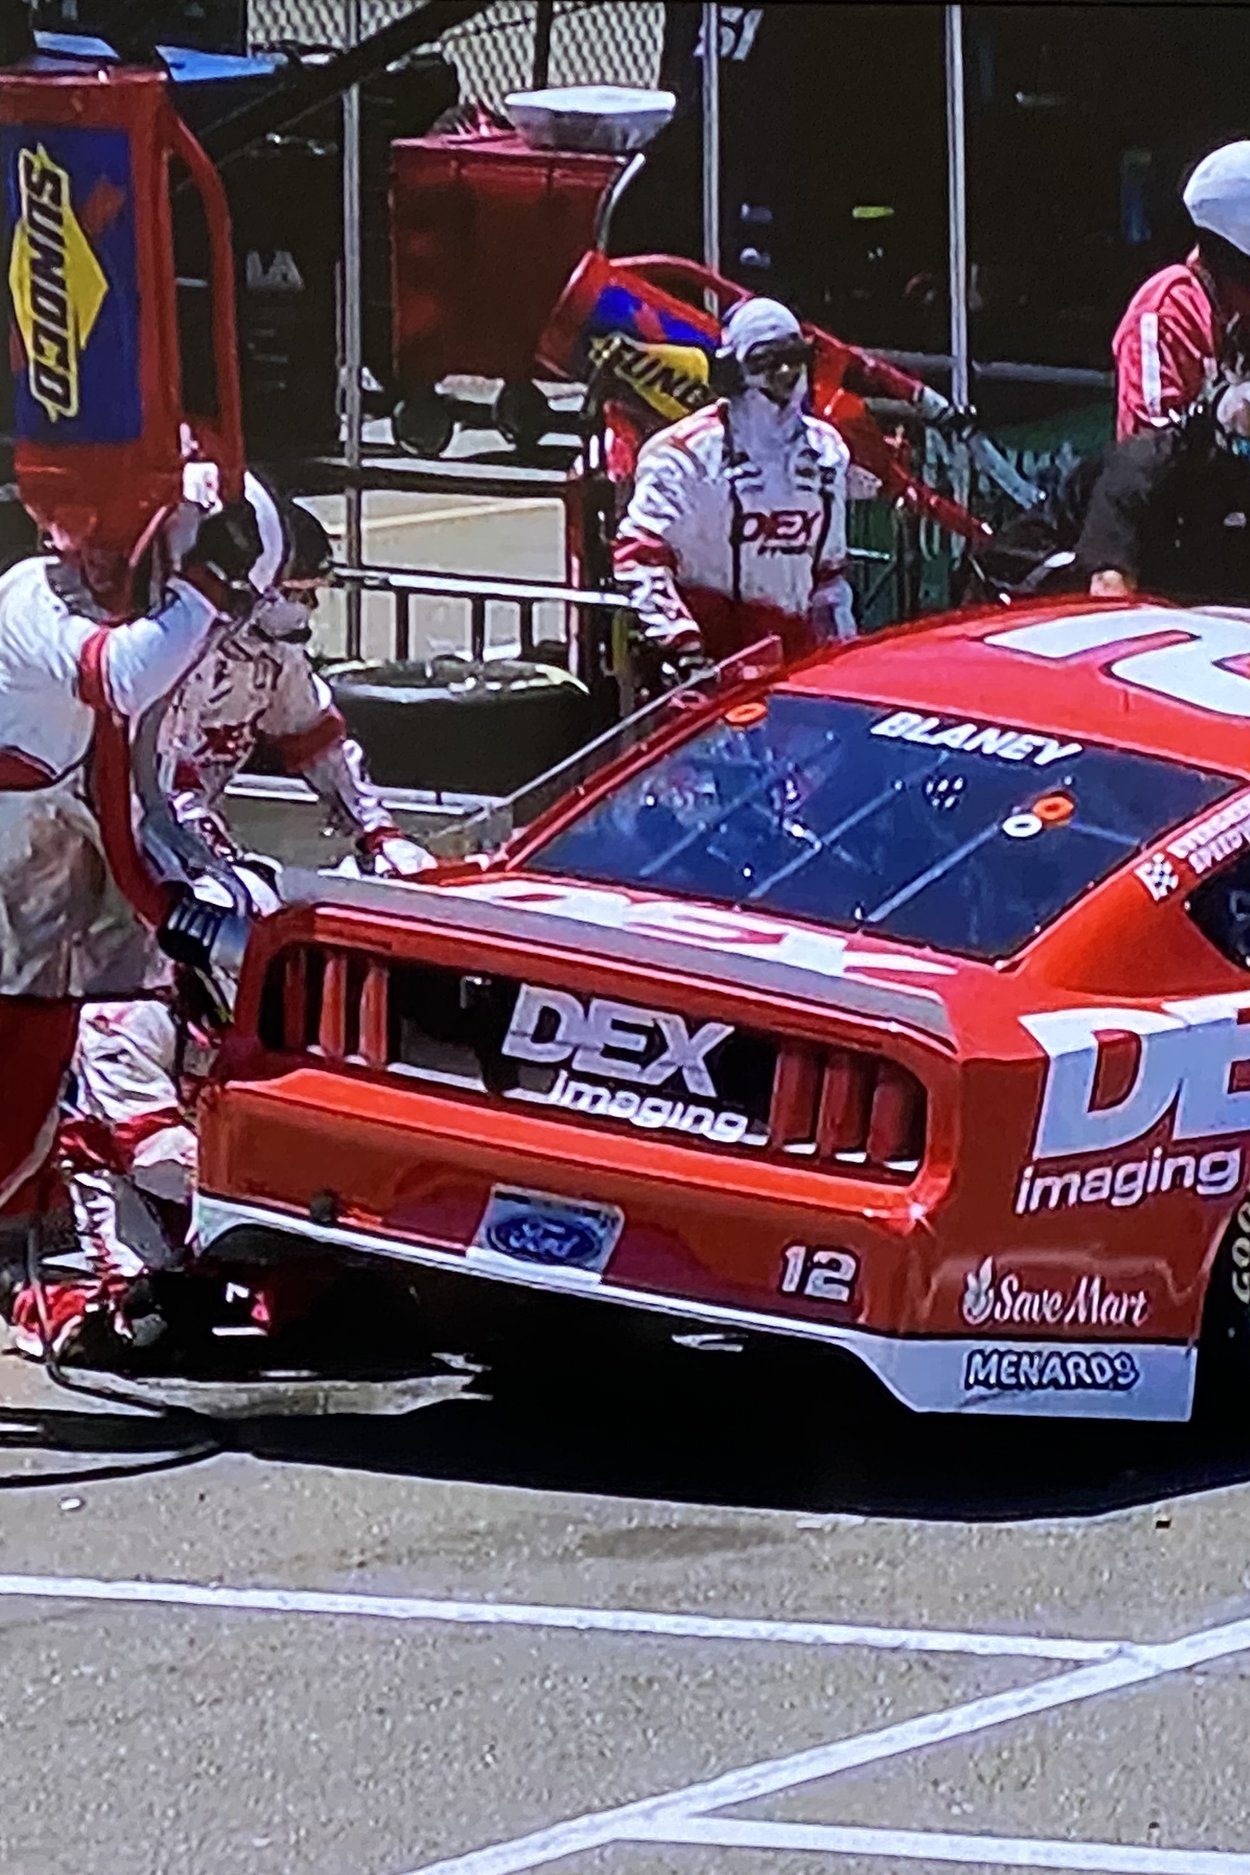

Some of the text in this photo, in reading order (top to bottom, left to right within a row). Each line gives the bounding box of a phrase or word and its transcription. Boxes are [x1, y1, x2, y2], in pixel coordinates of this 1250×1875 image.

[21, 148, 75, 412] SUNOCO
[869, 711, 1083, 766] BLANEY
[501, 983, 736, 1098] DEX
[549, 1068, 749, 1143] imaging
[1015, 1147, 1242, 1215] imaging
[780, 1245, 858, 1302] 12
[993, 1272, 1149, 1328] Save Mart
[965, 1350, 1139, 1391] MENARDS
